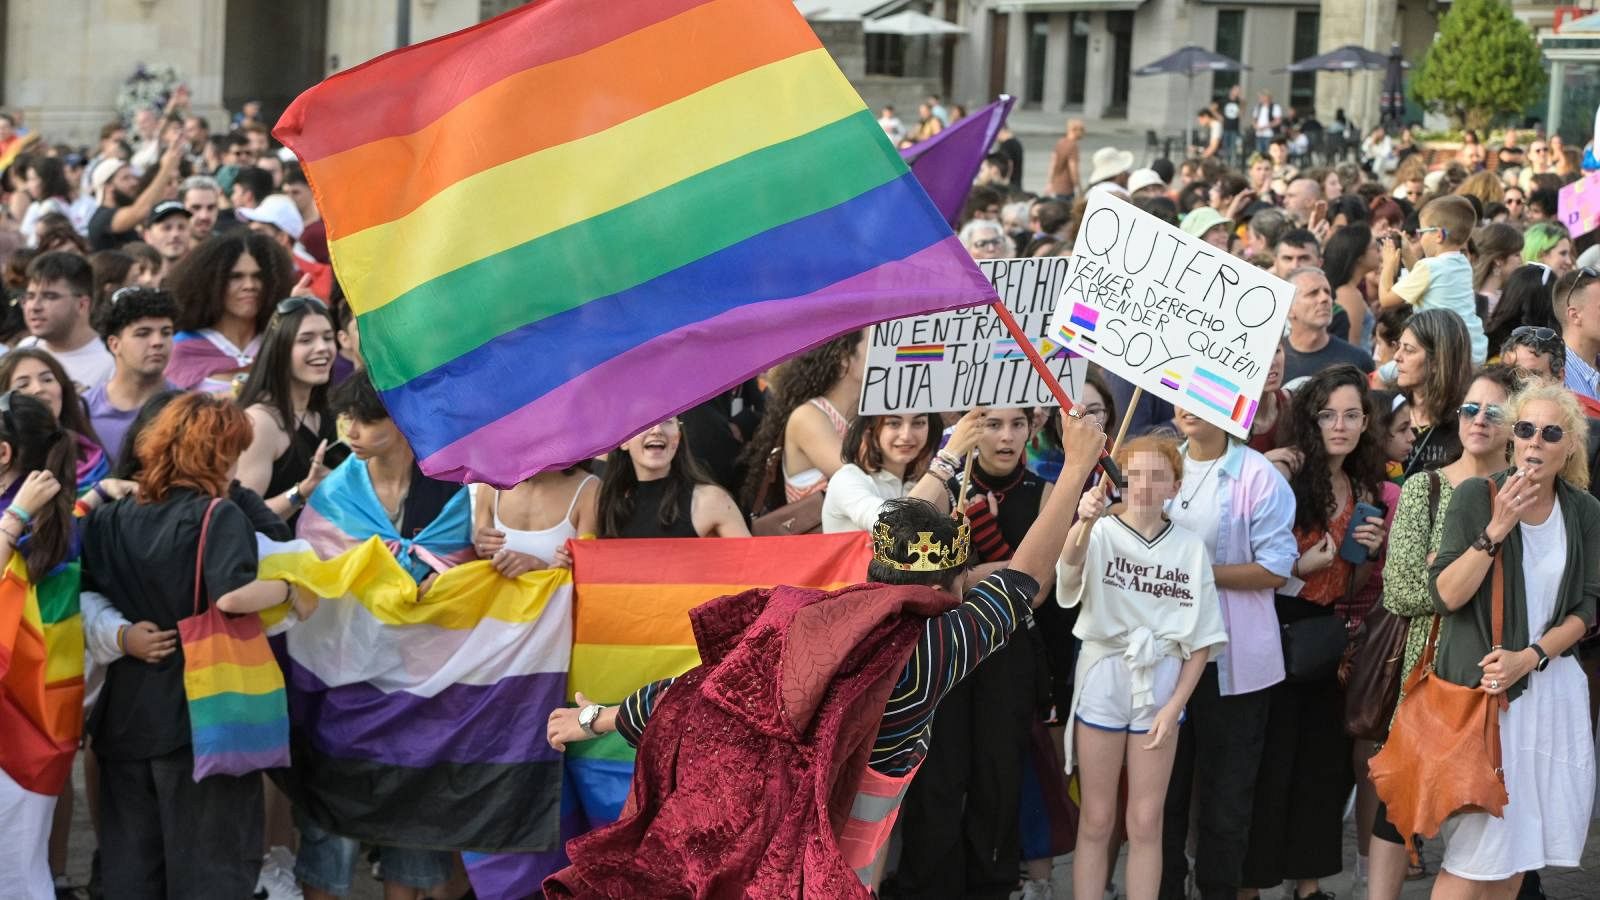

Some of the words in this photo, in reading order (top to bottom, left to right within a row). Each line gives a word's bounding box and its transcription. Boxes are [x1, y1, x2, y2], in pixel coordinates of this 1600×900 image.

[1085, 207, 1277, 329] QUIERO
[1064, 275, 1170, 333] APRENDER
[1187, 330, 1261, 380] QUIÉN
[1073, 254, 1135, 299] TENER
[1143, 286, 1225, 333] DERECHO
[1231, 332, 1249, 349] A
[873, 320, 903, 348] NO
[946, 342, 991, 366] TU
[1101, 318, 1191, 374] SOY
[860, 362, 933, 412] PUTA
[950, 349, 1075, 409] POLÍTICA
[1155, 564, 1190, 584] Lake
